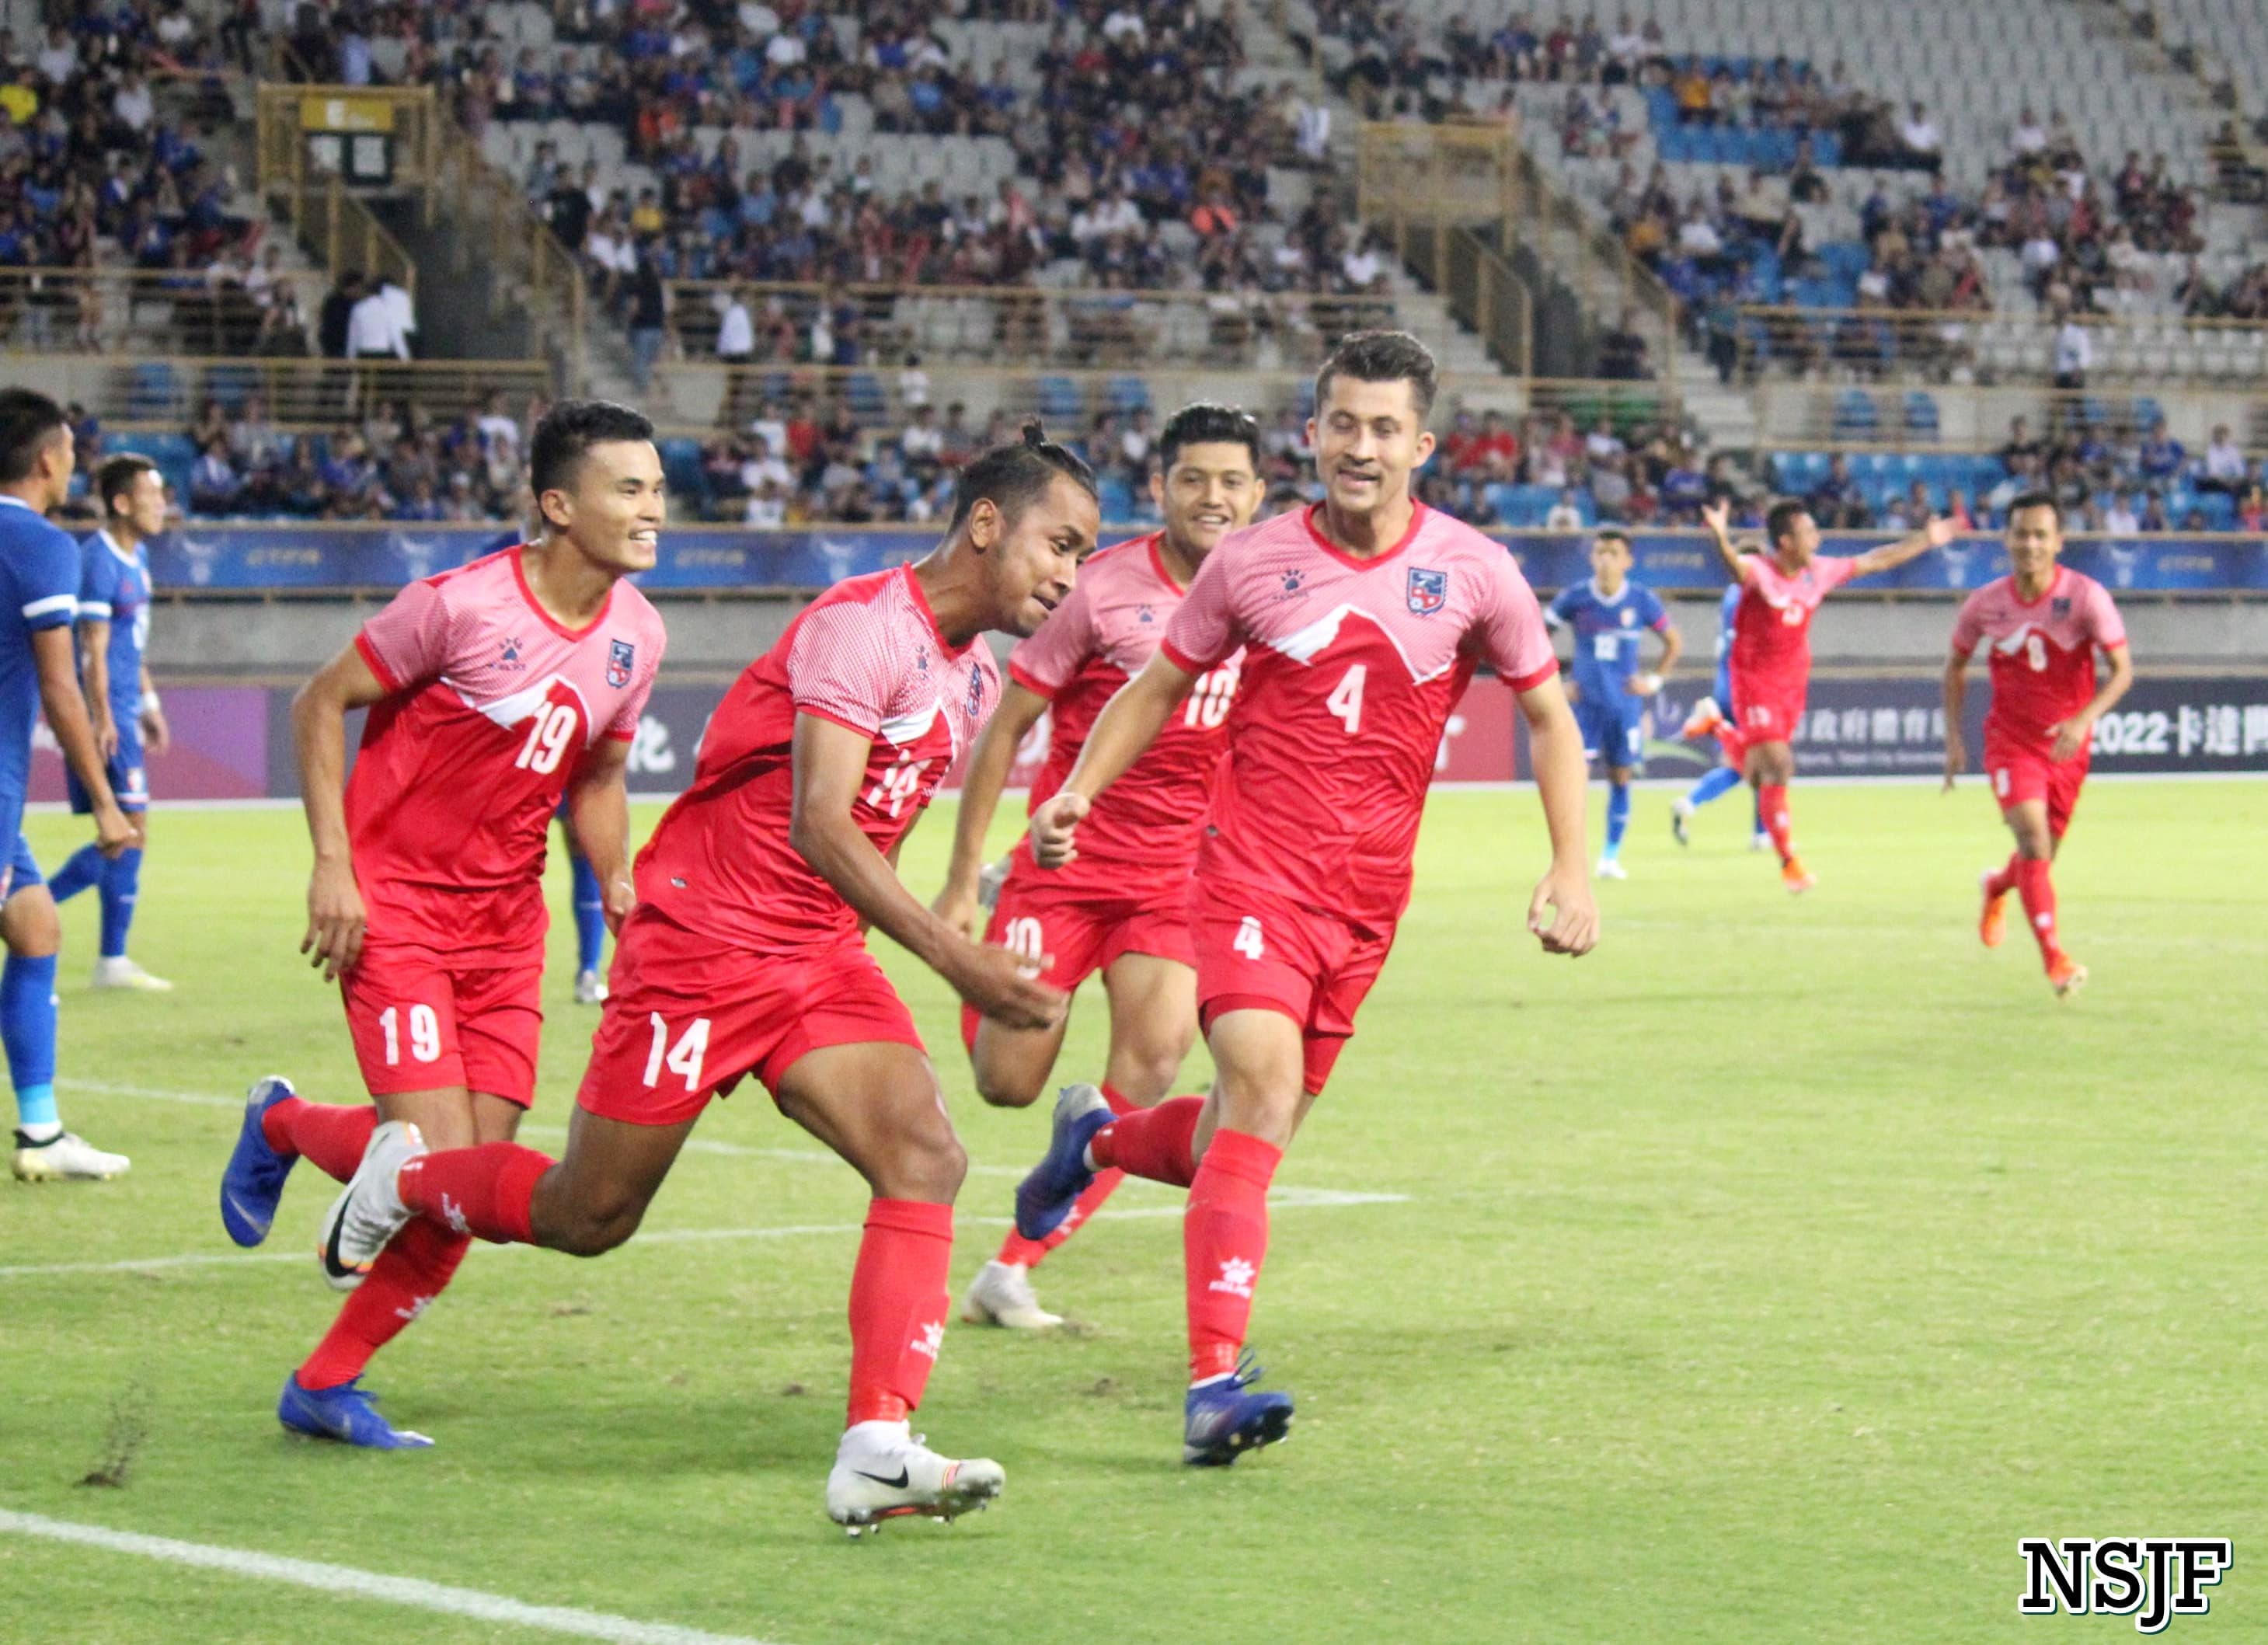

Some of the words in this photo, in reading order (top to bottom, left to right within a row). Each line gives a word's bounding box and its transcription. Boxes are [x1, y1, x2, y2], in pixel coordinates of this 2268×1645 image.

[1184, 670, 1238, 727] 10
[1326, 664, 1367, 733] 4
[514, 701, 577, 775] 19
[866, 748, 932, 817] 14
[1005, 917, 1043, 981] 10
[1233, 915, 1265, 960] 4
[380, 1004, 440, 1065] 19
[643, 1011, 711, 1092] 14
